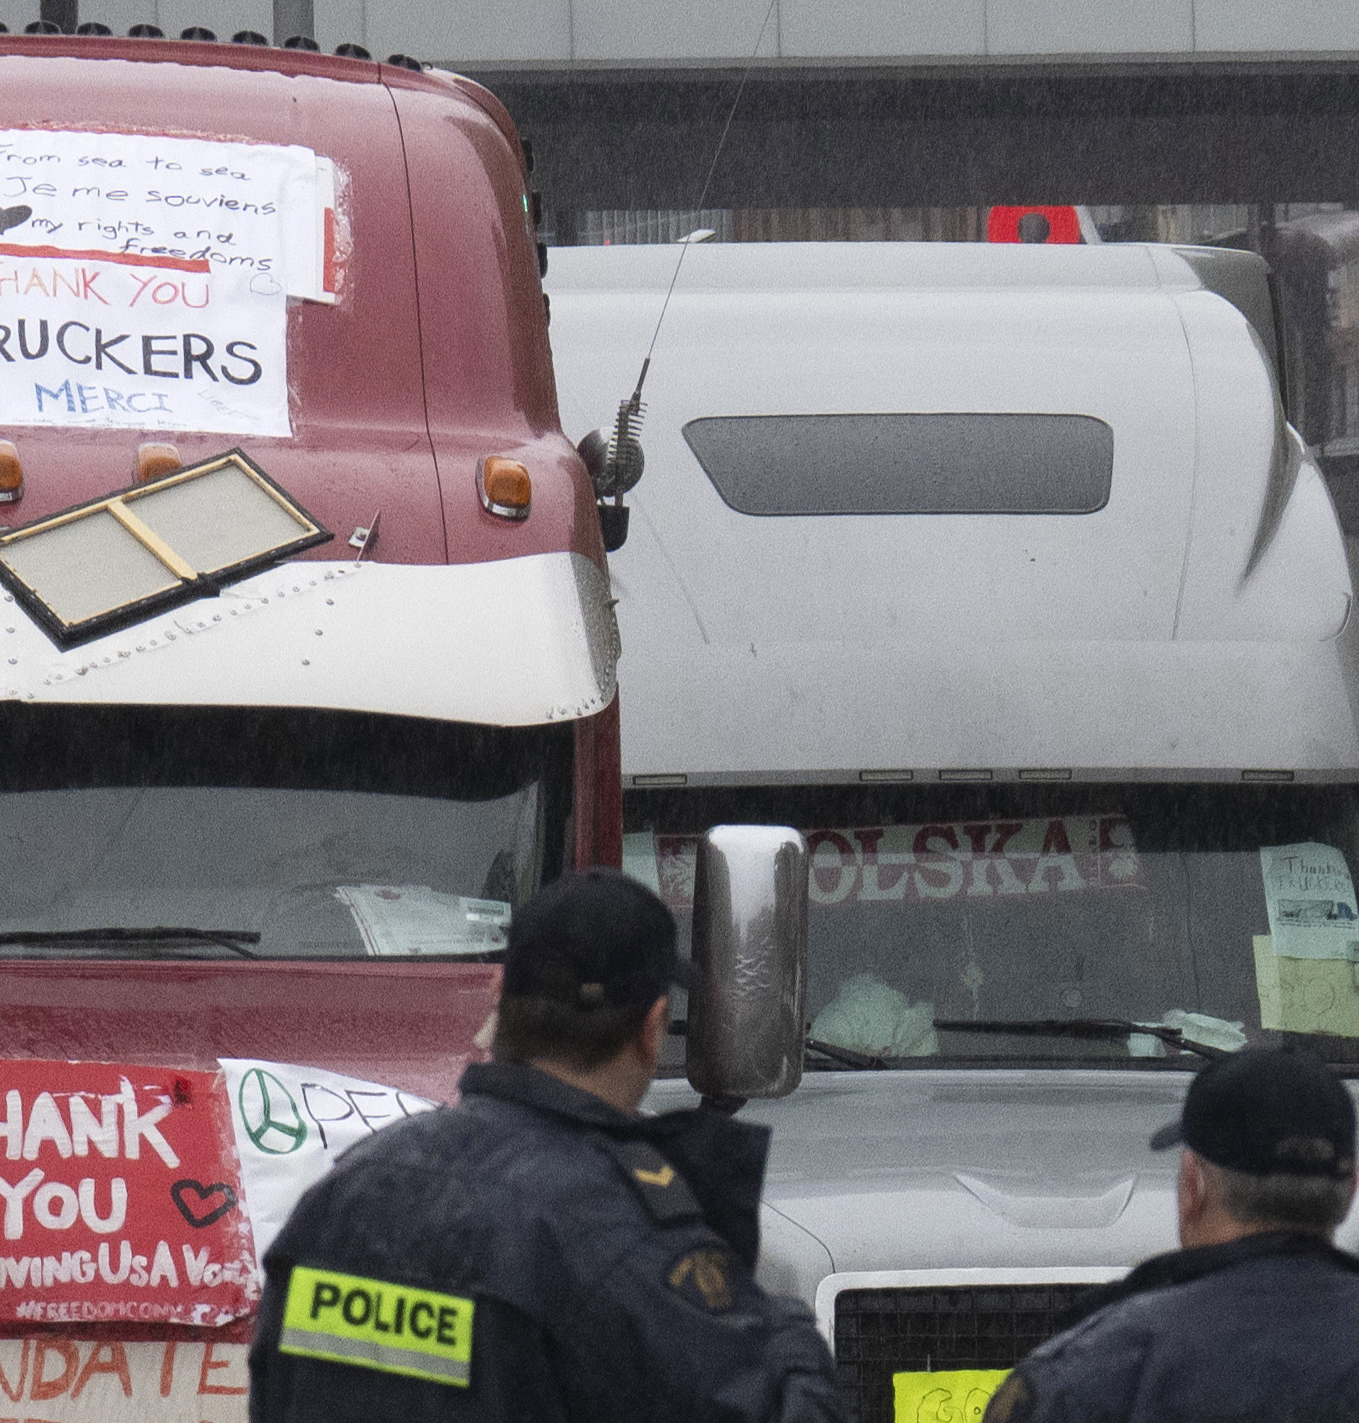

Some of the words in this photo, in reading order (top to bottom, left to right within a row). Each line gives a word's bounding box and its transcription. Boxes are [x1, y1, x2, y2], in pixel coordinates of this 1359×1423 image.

[78, 155, 125, 169] sea
[146, 155, 184, 172] to
[199, 165, 252, 183] sea
[2, 175, 57, 198] Je
[71, 184, 130, 202] me
[146, 187, 277, 217] souviens
[31, 217, 64, 236] my
[77, 216, 155, 240] rights
[173, 227, 238, 248] and
[118, 238, 274, 273] freedoms
[128, 272, 211, 309] YOU
[33, 379, 174, 414] MERCI
[807, 817, 1089, 904] OLSKA
[310, 1281, 457, 1346] POLICE
